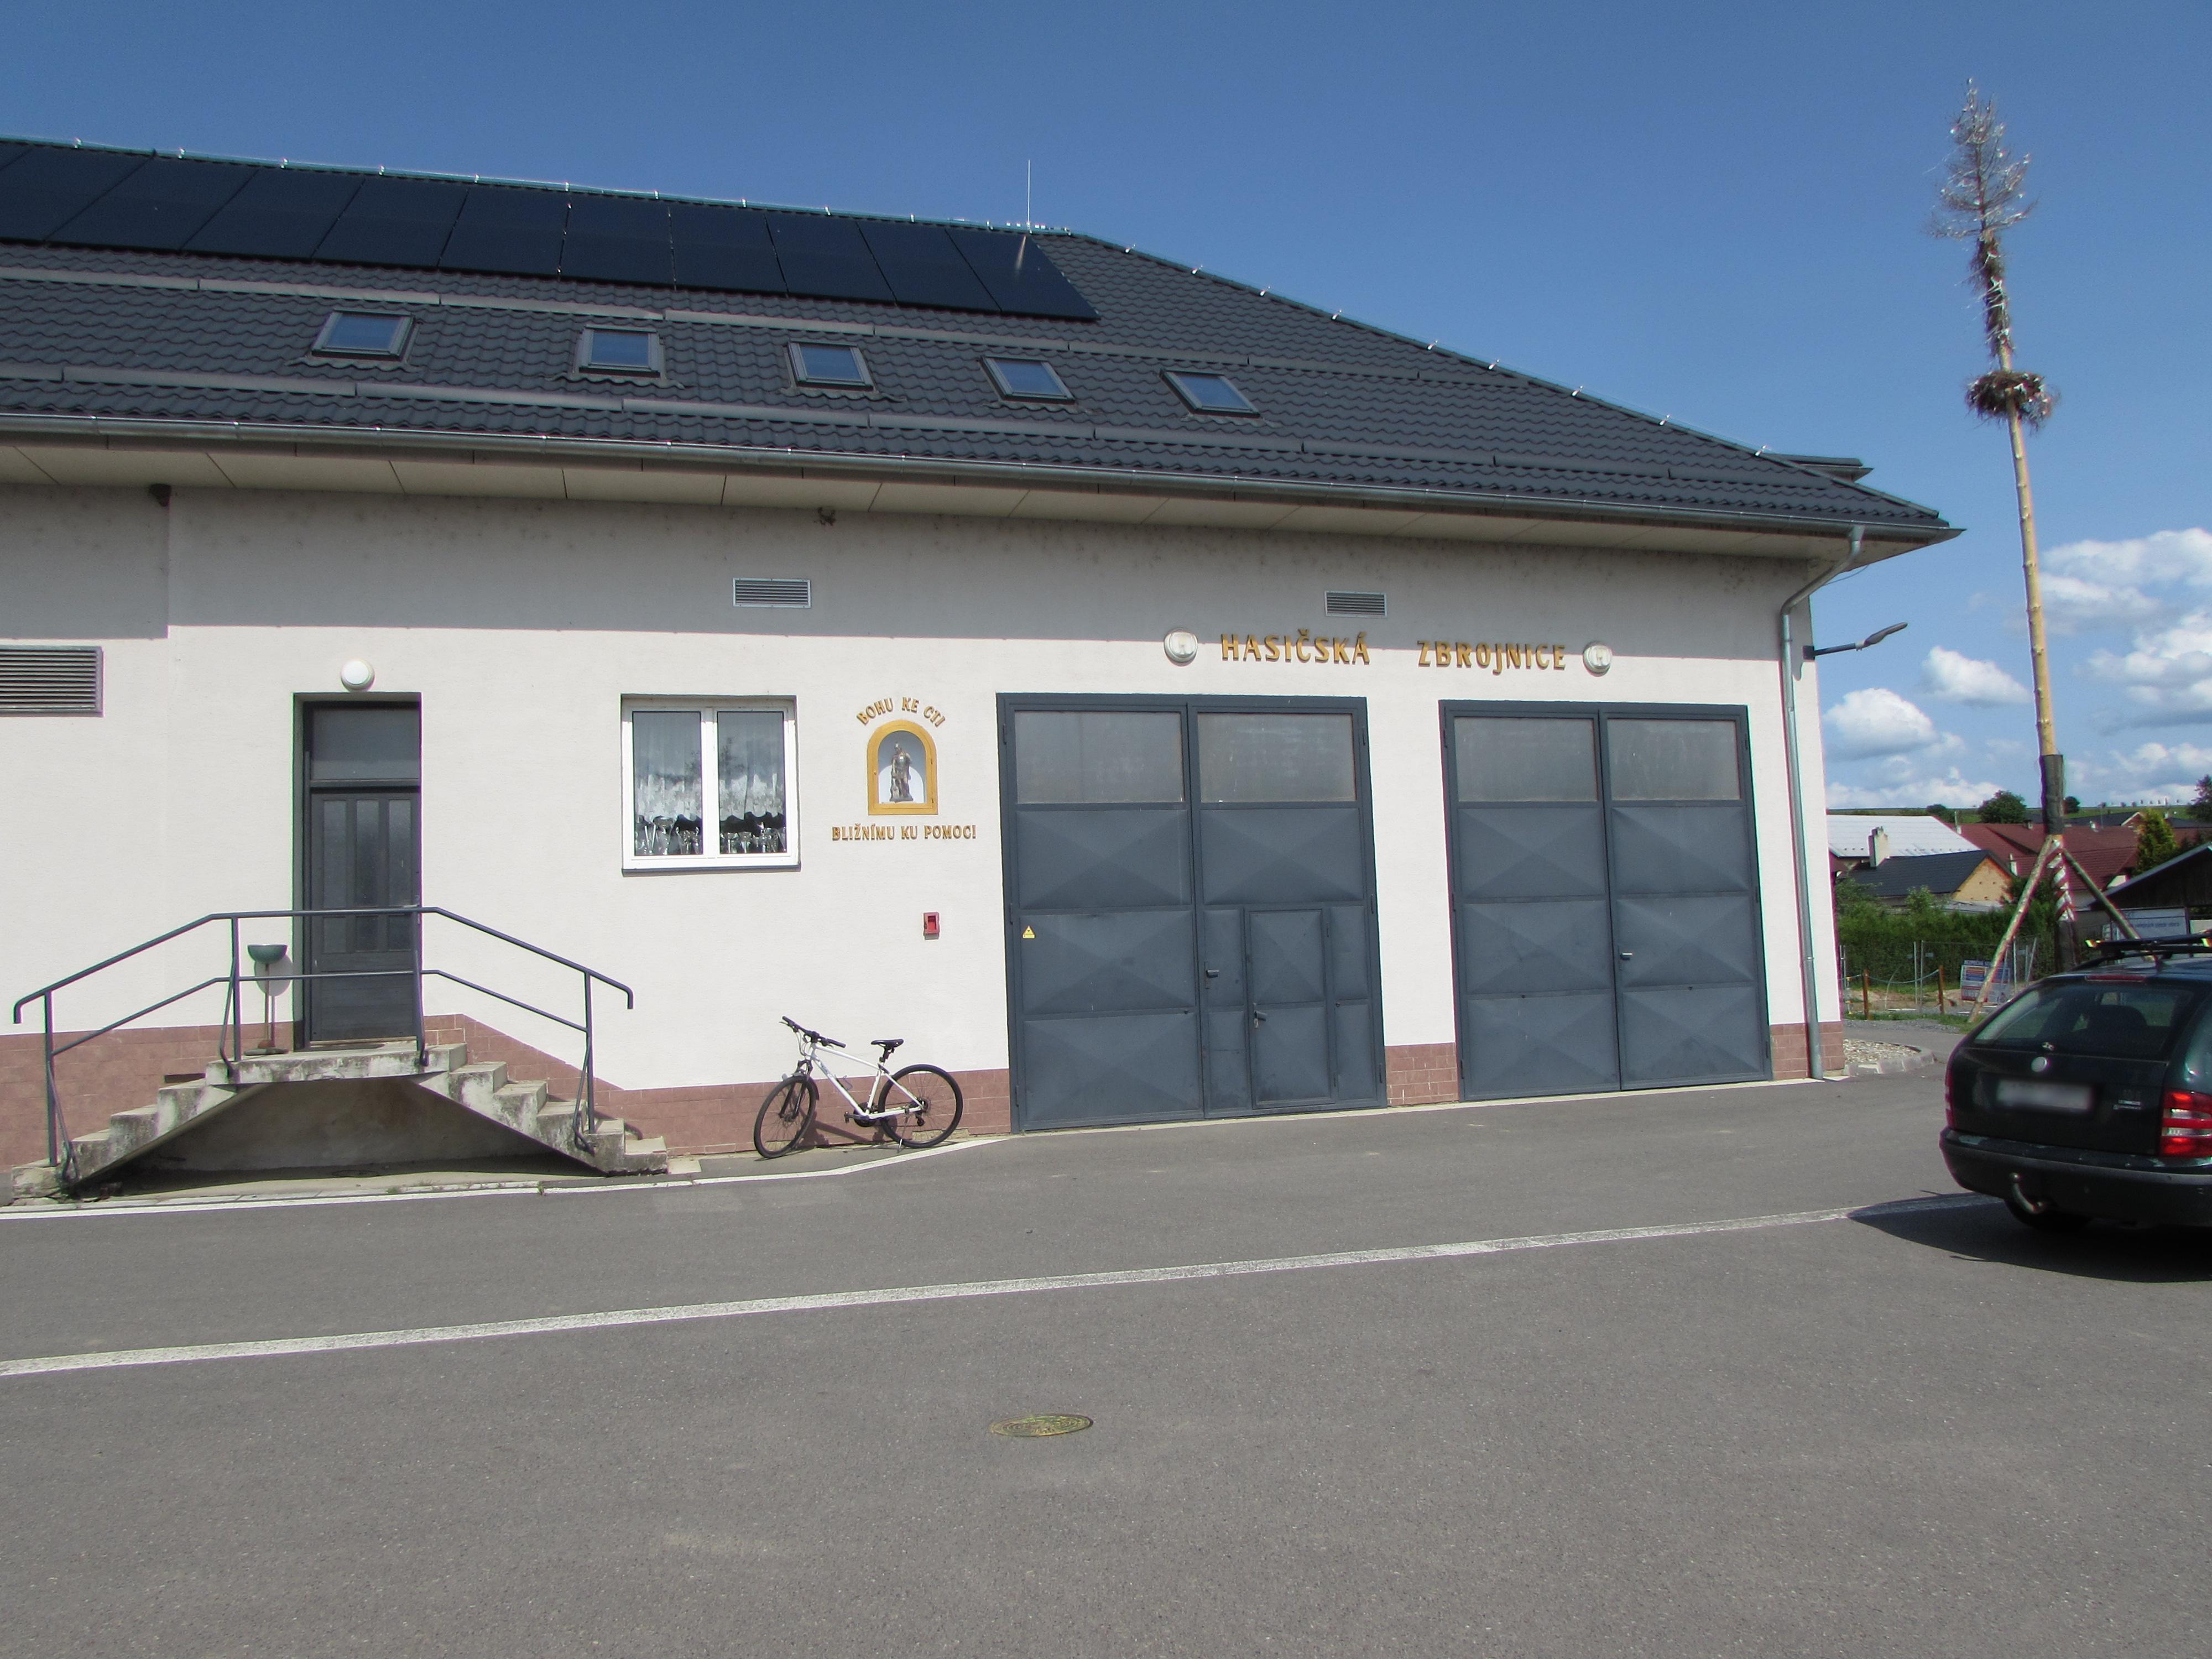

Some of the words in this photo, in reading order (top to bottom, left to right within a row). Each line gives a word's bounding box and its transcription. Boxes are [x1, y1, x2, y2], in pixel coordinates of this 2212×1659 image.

[1221, 629, 1370, 665] HASIČSKÁ
[1417, 640, 1566, 676] ZBROJNICE
[857, 698, 893, 726] BOHU
[901, 697, 919, 714] KE
[924, 706, 946, 727] CTI
[832, 823, 895, 841] BLIŽNÍMU
[901, 826, 918, 840] KU
[924, 825, 977, 840] POMOCI
